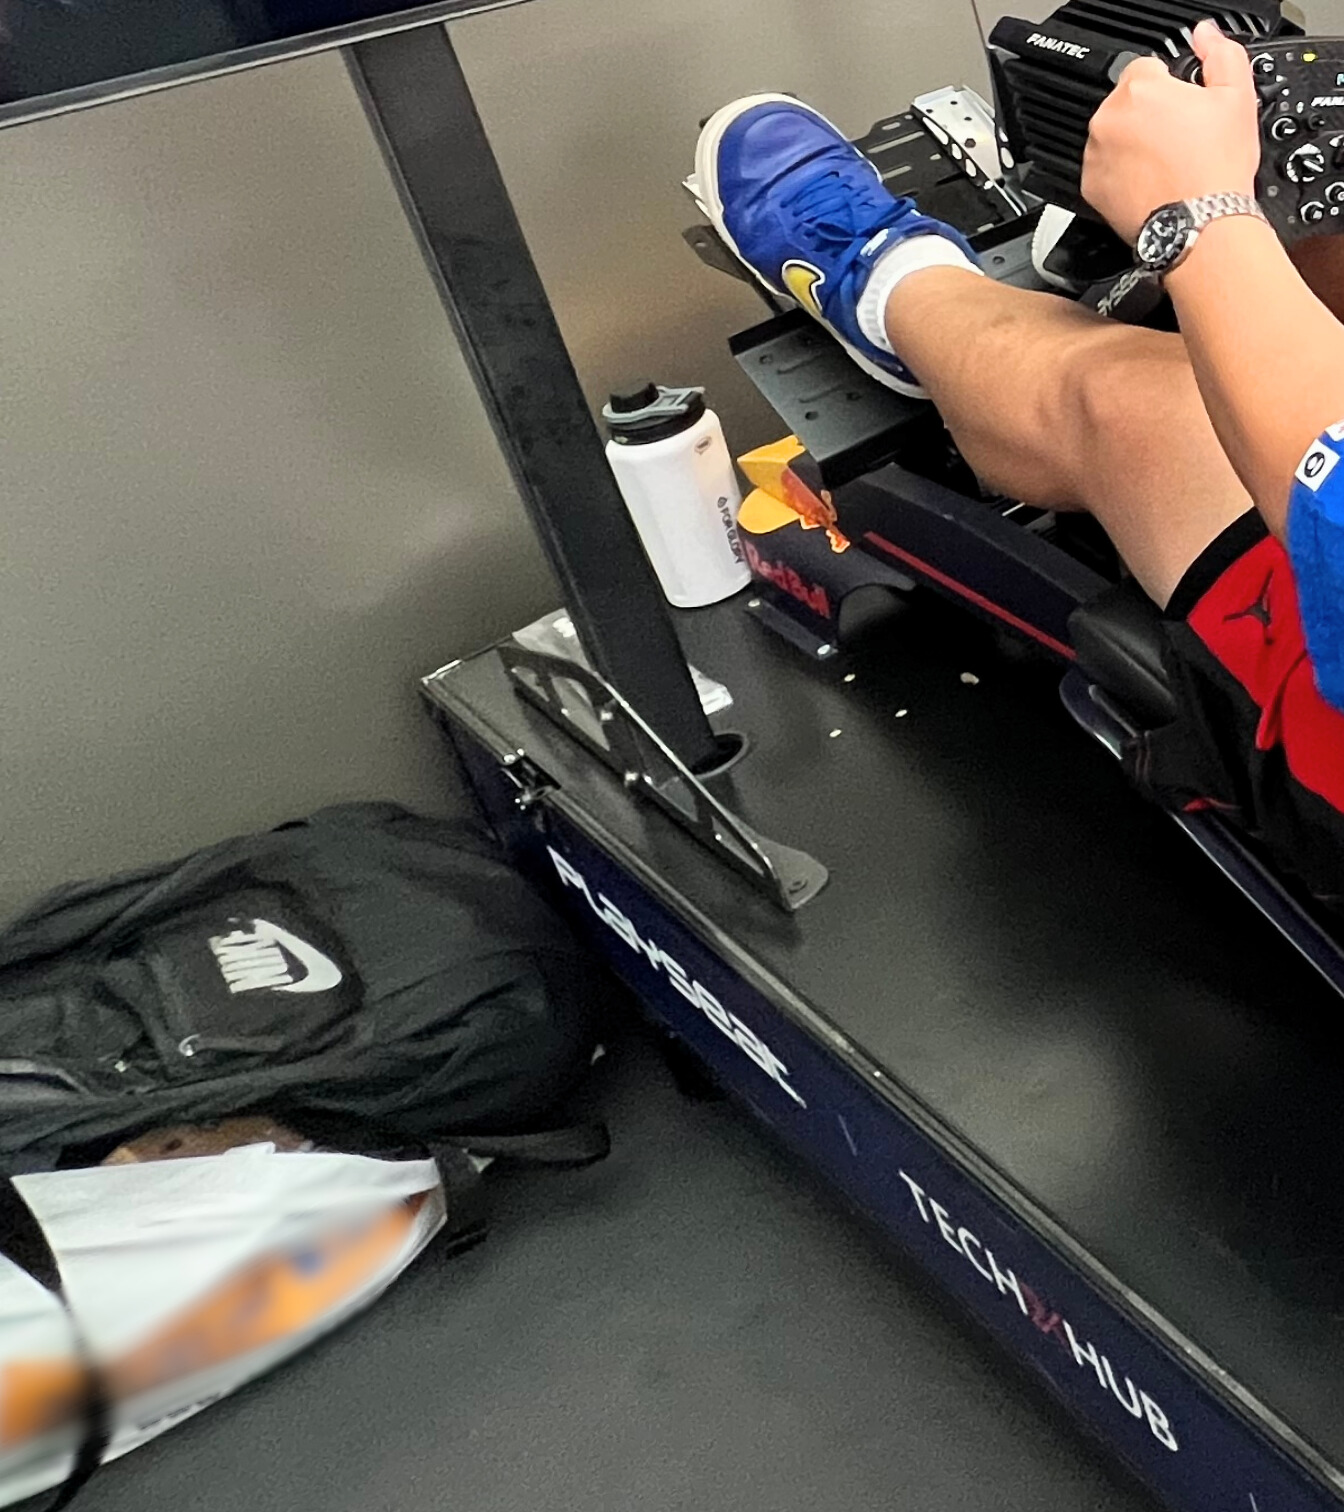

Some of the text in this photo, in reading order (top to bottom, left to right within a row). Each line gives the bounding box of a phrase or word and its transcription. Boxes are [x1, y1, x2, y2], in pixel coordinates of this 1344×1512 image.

[1026, 32, 1090, 59] FANATEC
[899, 1170, 1029, 1316] TECH
[1062, 1319, 1178, 1452] HUB
